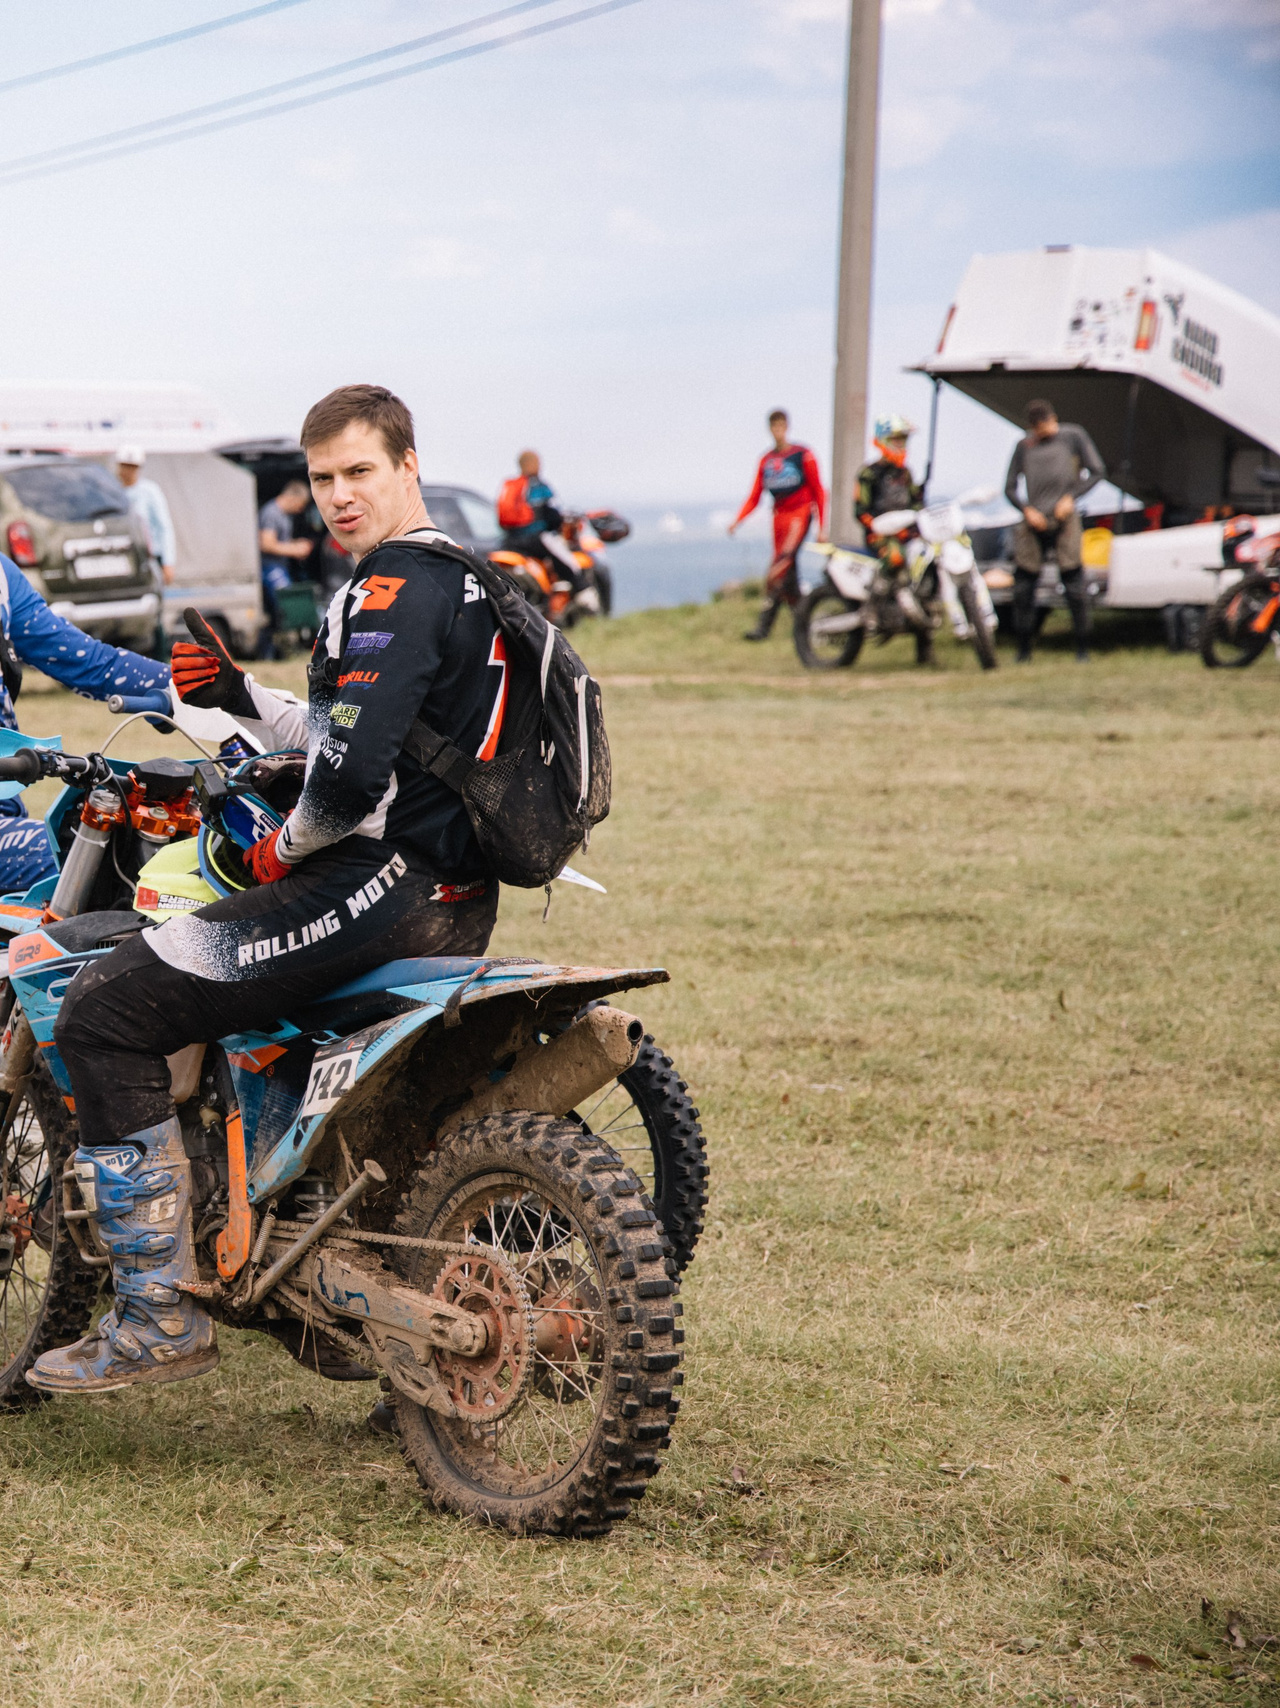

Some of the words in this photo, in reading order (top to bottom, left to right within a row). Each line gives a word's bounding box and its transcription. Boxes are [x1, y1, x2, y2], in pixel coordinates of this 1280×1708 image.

[238, 908, 341, 968] ROLLING
[345, 852, 409, 920] MOTO
[306, 1059, 353, 1106] 142
